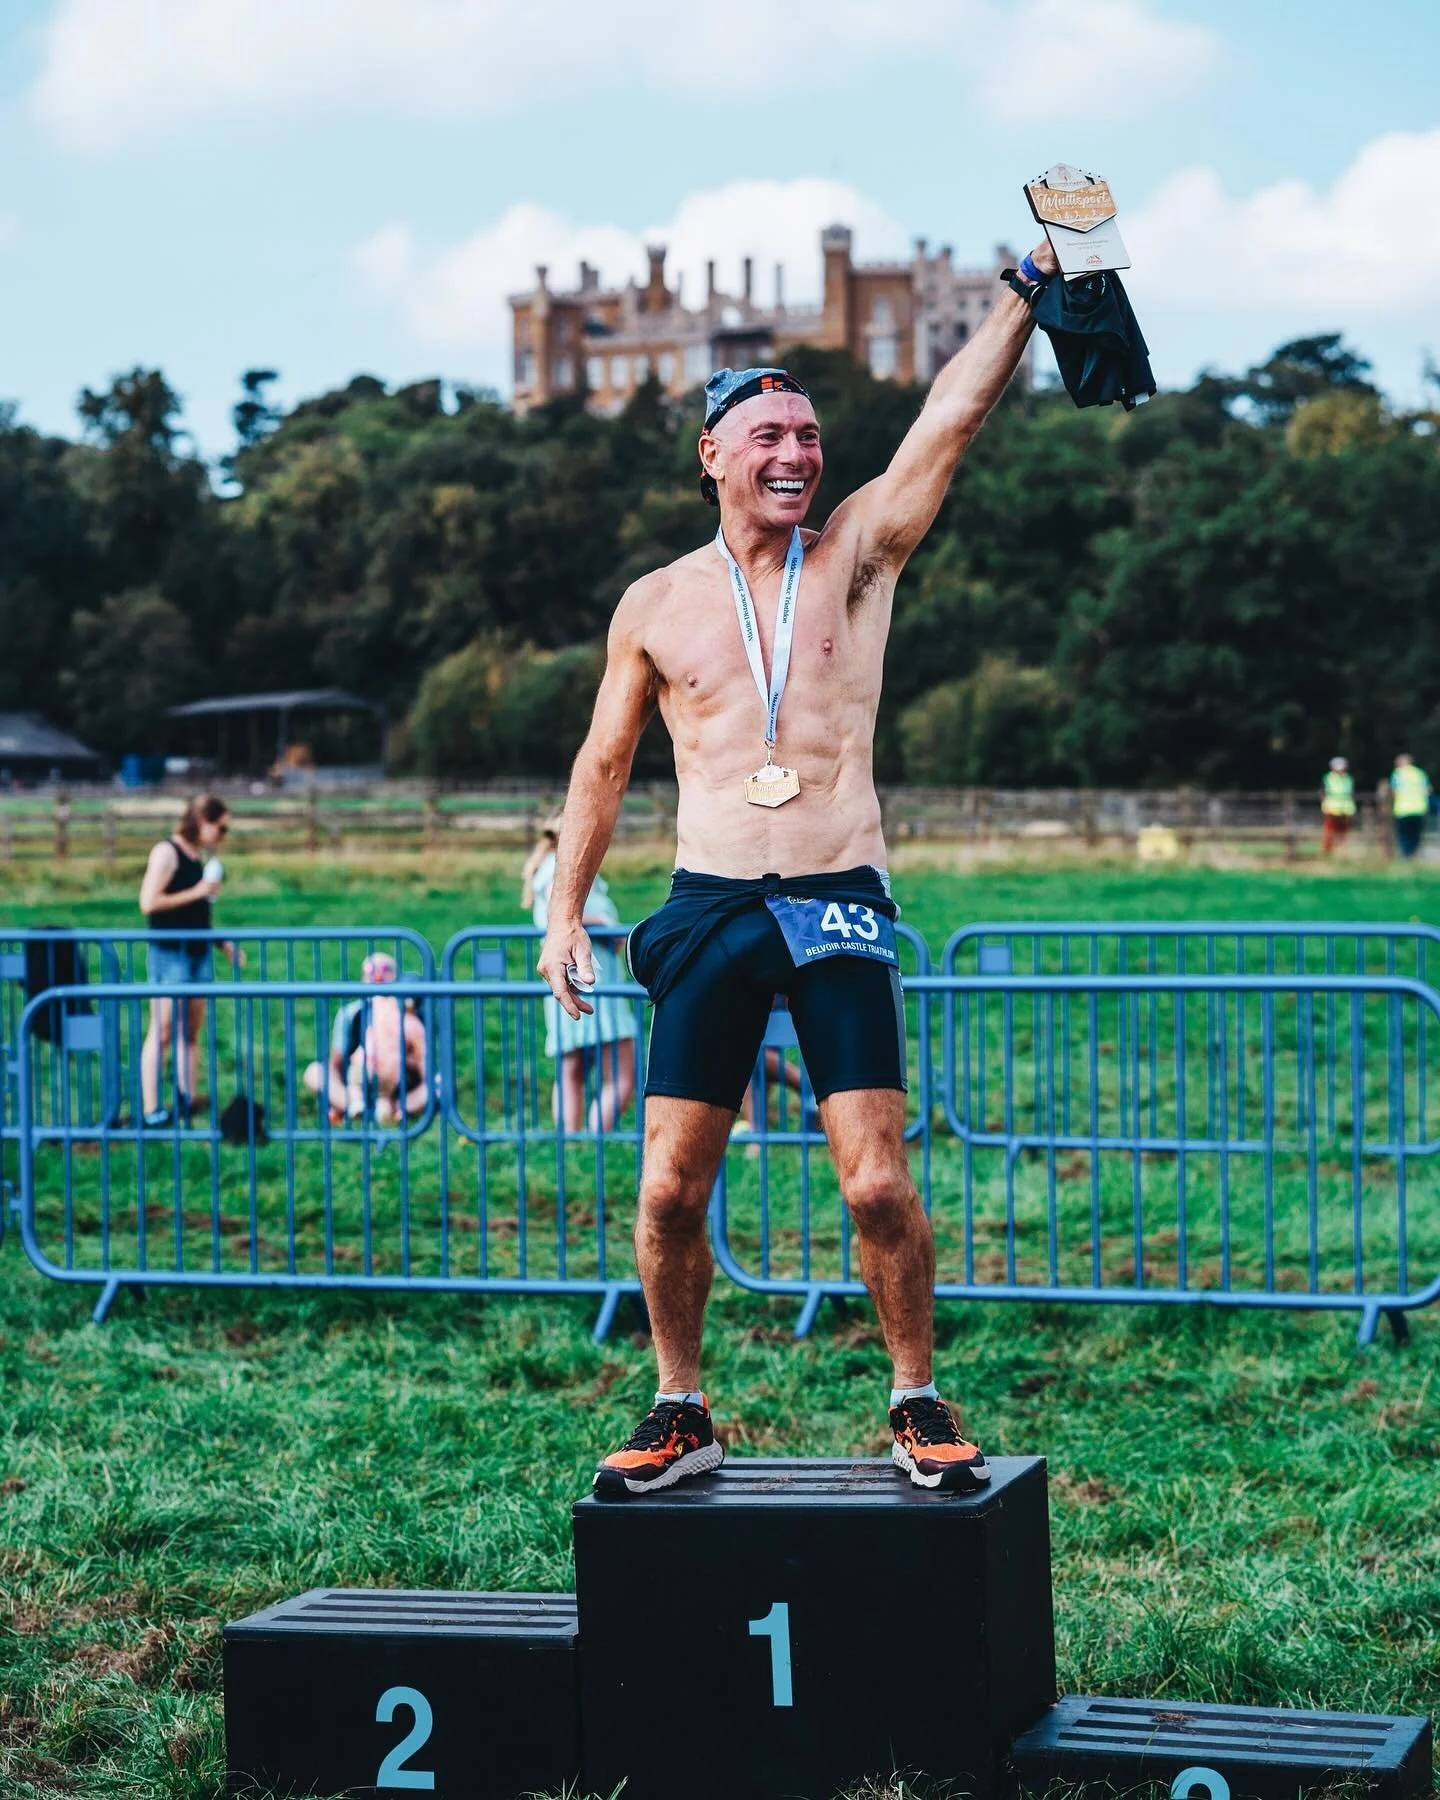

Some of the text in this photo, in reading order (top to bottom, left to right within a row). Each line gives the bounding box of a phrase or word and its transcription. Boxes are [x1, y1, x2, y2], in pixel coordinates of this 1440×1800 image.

[1036, 191, 1109, 211] Multisport
[782, 596, 791, 624] Triathlon
[820, 902, 879, 941] 43
[805, 941, 895, 960] BELVOIR CASTLE TRIATHLON
[749, 1602, 793, 1706] 1
[376, 1686, 435, 1790] 2
